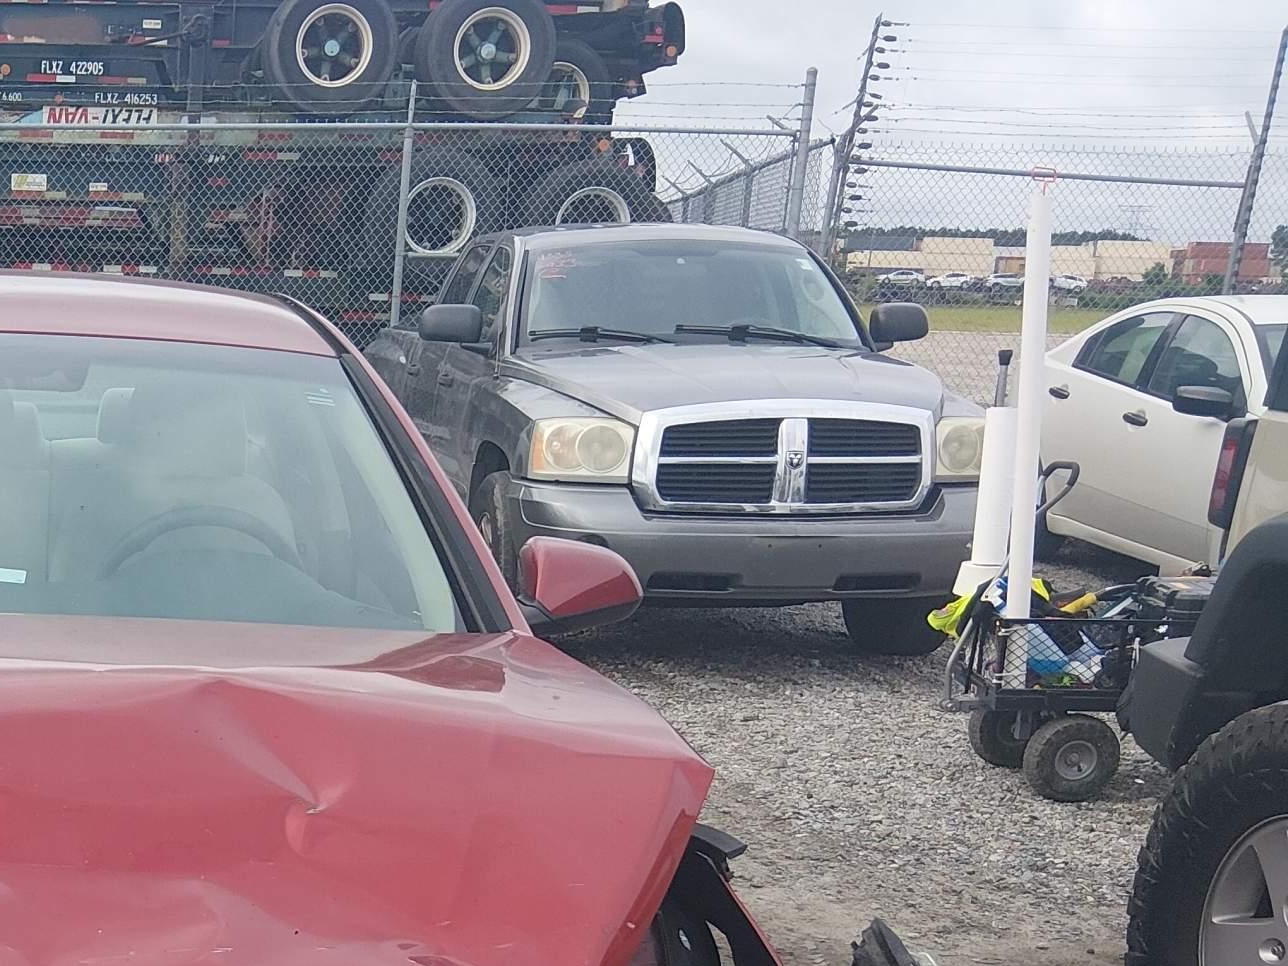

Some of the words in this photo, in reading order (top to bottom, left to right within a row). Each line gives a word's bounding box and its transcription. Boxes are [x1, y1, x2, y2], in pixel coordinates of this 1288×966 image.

[41, 60, 62, 74] FLXZ
[70, 61, 104, 75] 422905
[95, 93, 118, 103] FLXZ
[124, 93, 158, 105] 416253
[46, 106, 153, 125] FLEXI-VAN
